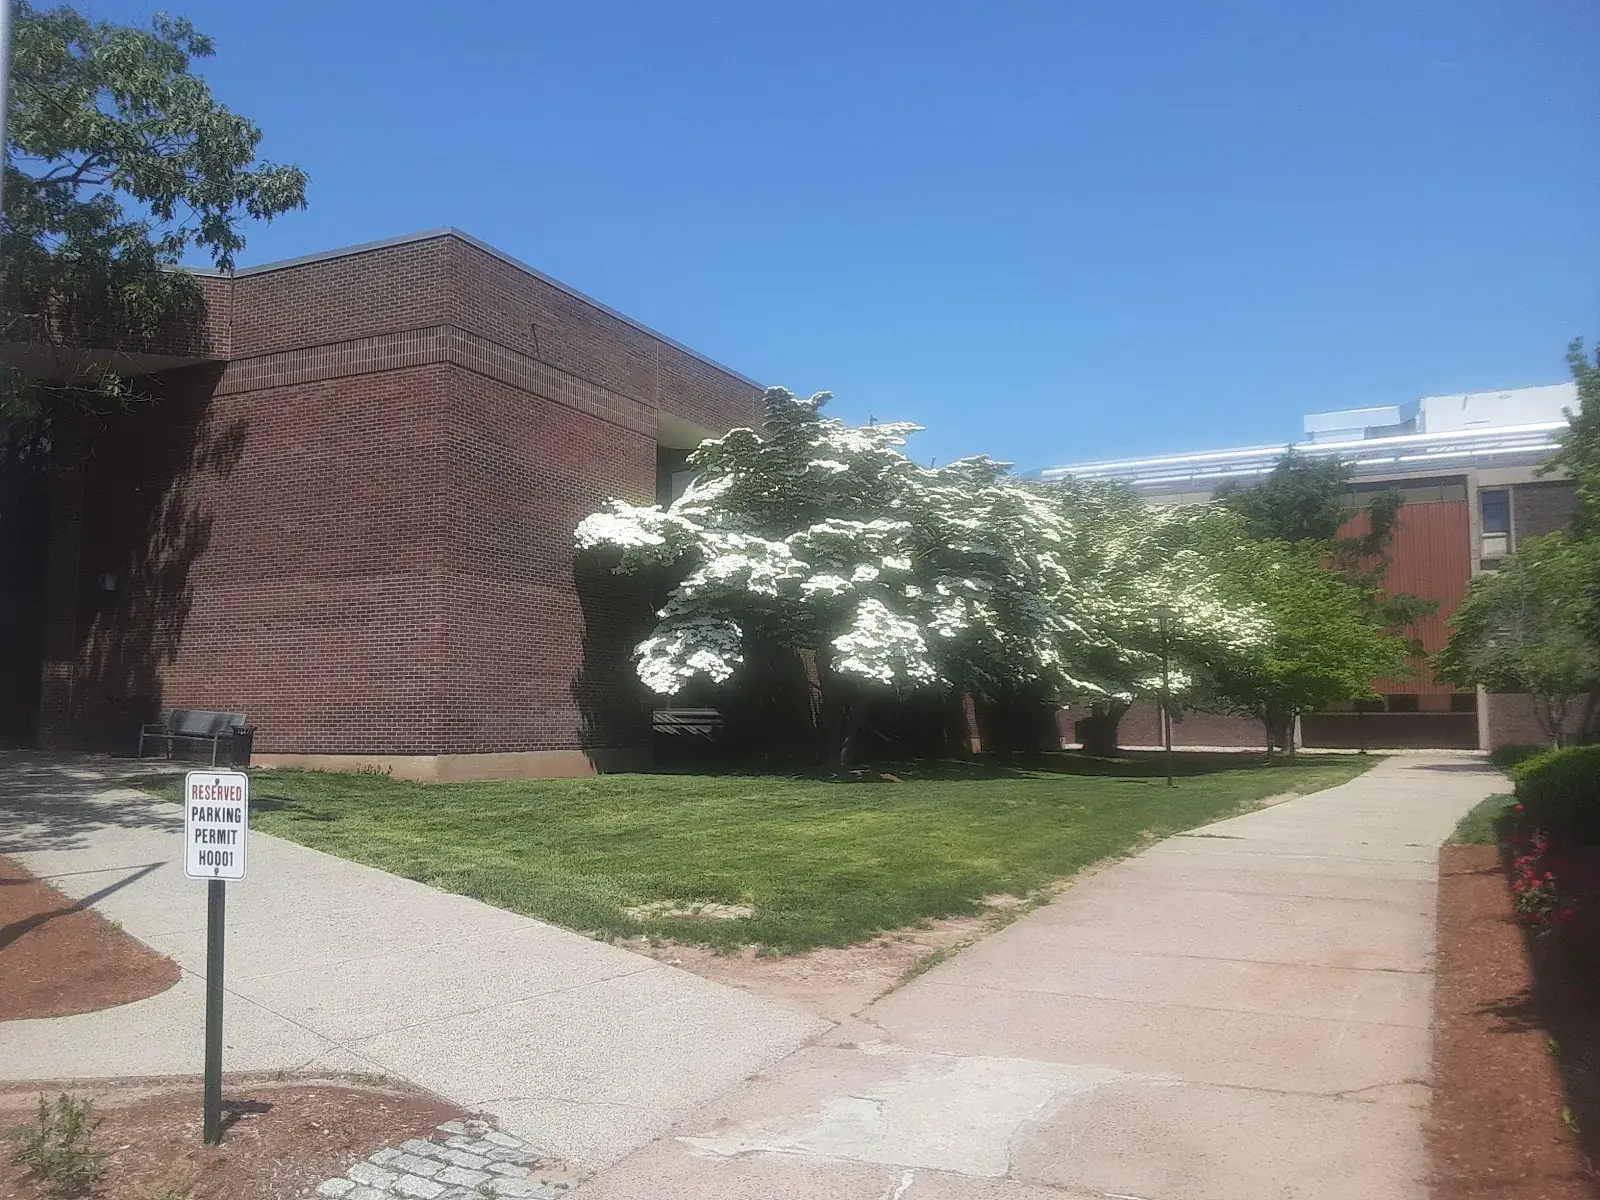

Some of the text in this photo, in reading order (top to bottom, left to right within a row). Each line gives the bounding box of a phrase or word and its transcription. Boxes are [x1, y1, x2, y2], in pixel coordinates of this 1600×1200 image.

[191, 784, 242, 802] RESERVED
[191, 806, 242, 824] PARKING
[194, 828, 238, 845] PERMIT
